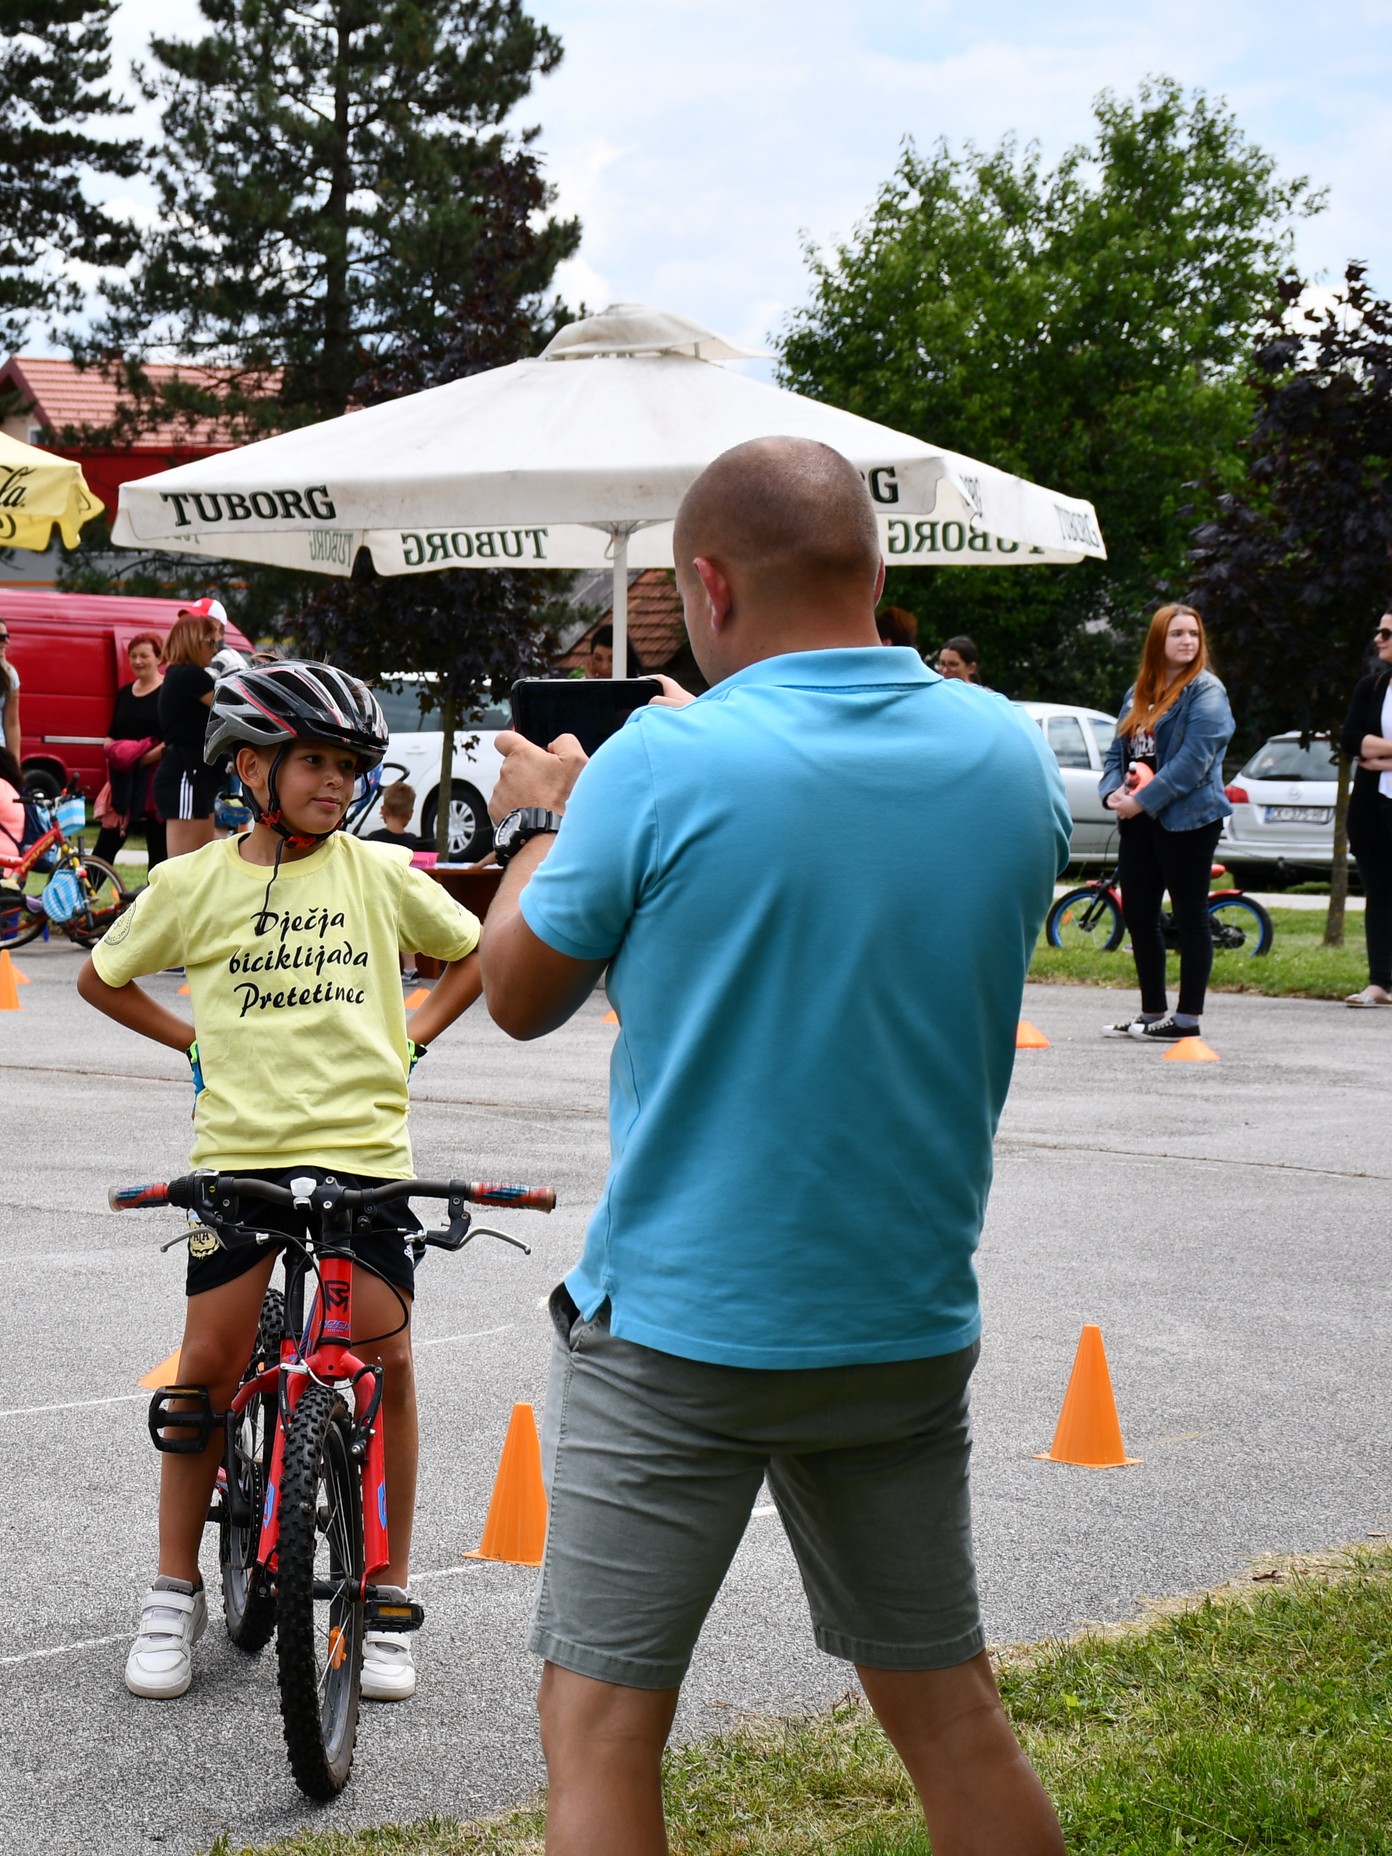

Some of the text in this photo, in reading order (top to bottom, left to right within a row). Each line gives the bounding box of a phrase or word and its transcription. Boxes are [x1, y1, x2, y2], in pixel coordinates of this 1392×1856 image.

[160, 485, 337, 527] TUBORG
[250, 907, 345, 942] Dječja
[229, 941, 369, 977] biciklijada
[234, 981, 366, 1018] Pretetinec
